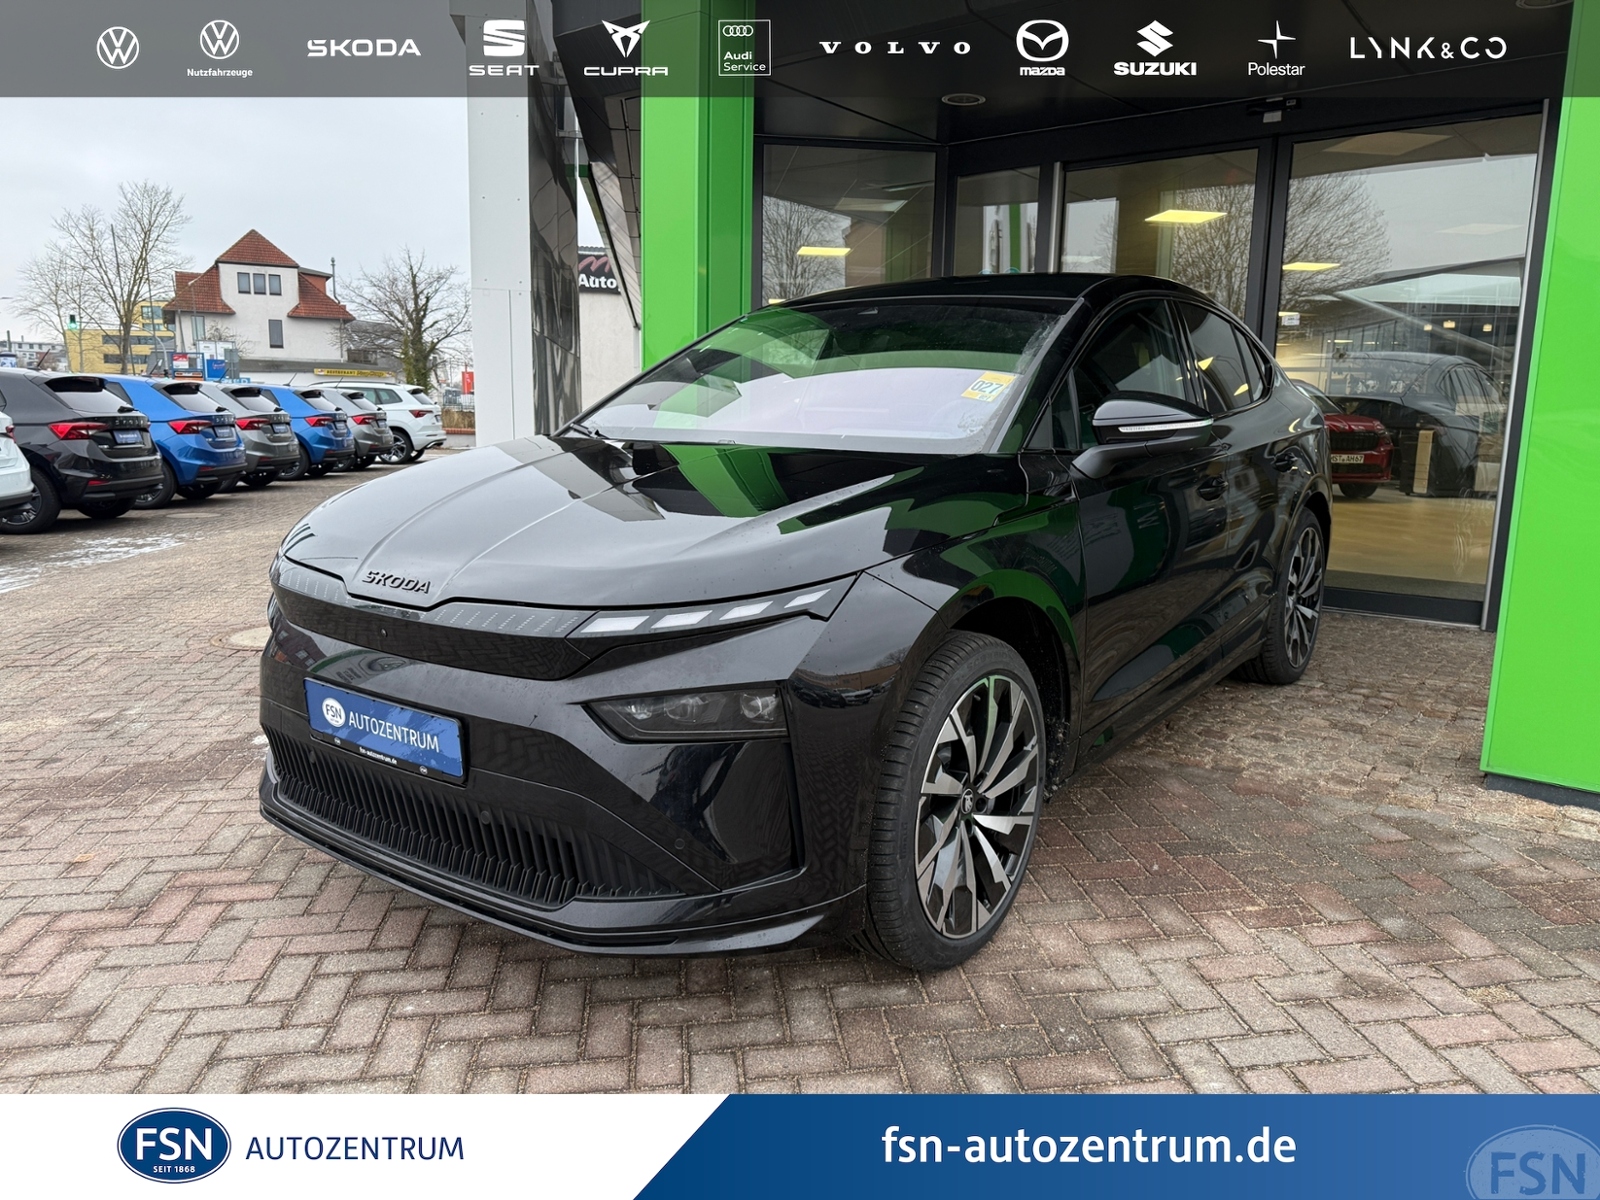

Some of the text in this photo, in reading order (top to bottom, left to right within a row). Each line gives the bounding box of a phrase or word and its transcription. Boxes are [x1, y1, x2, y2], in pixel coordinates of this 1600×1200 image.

[970, 380, 1004, 394] 027
[325, 703, 440, 753] FSN AUTOZENTRUM
